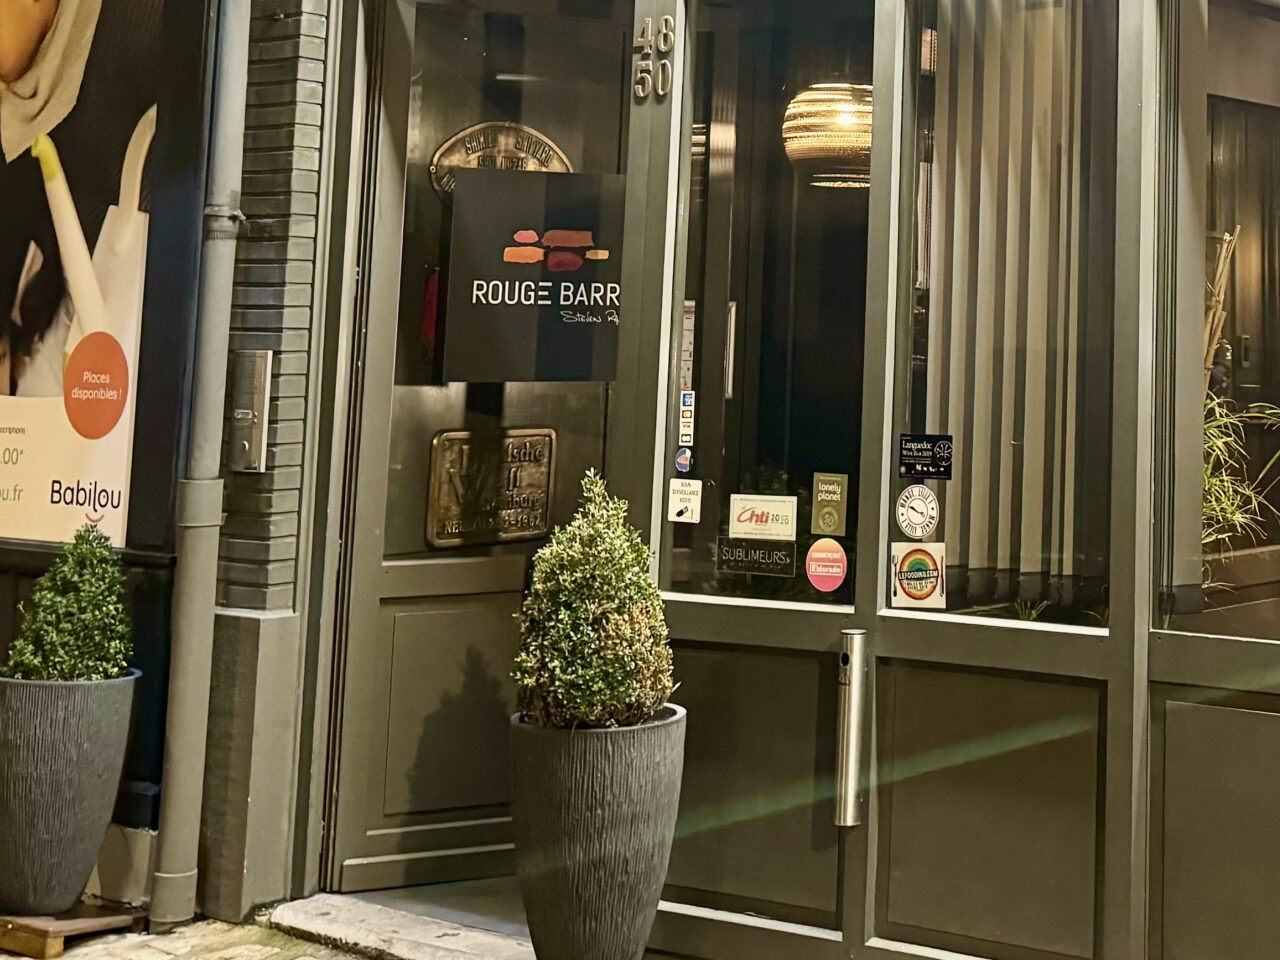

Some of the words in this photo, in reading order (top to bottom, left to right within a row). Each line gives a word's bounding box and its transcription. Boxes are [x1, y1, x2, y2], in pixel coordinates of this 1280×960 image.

[633, 14, 674, 54] 48
[634, 59, 672, 97] 50
[471, 279, 553, 305] ROUGE
[83, 370, 111, 384] Places
[71, 387, 118, 401] disponibles
[49, 479, 122, 513] Babilou
[818, 481, 841, 494] lonely
[817, 491, 841, 502] planet
[722, 547, 787, 564] SUBLIMEURS
